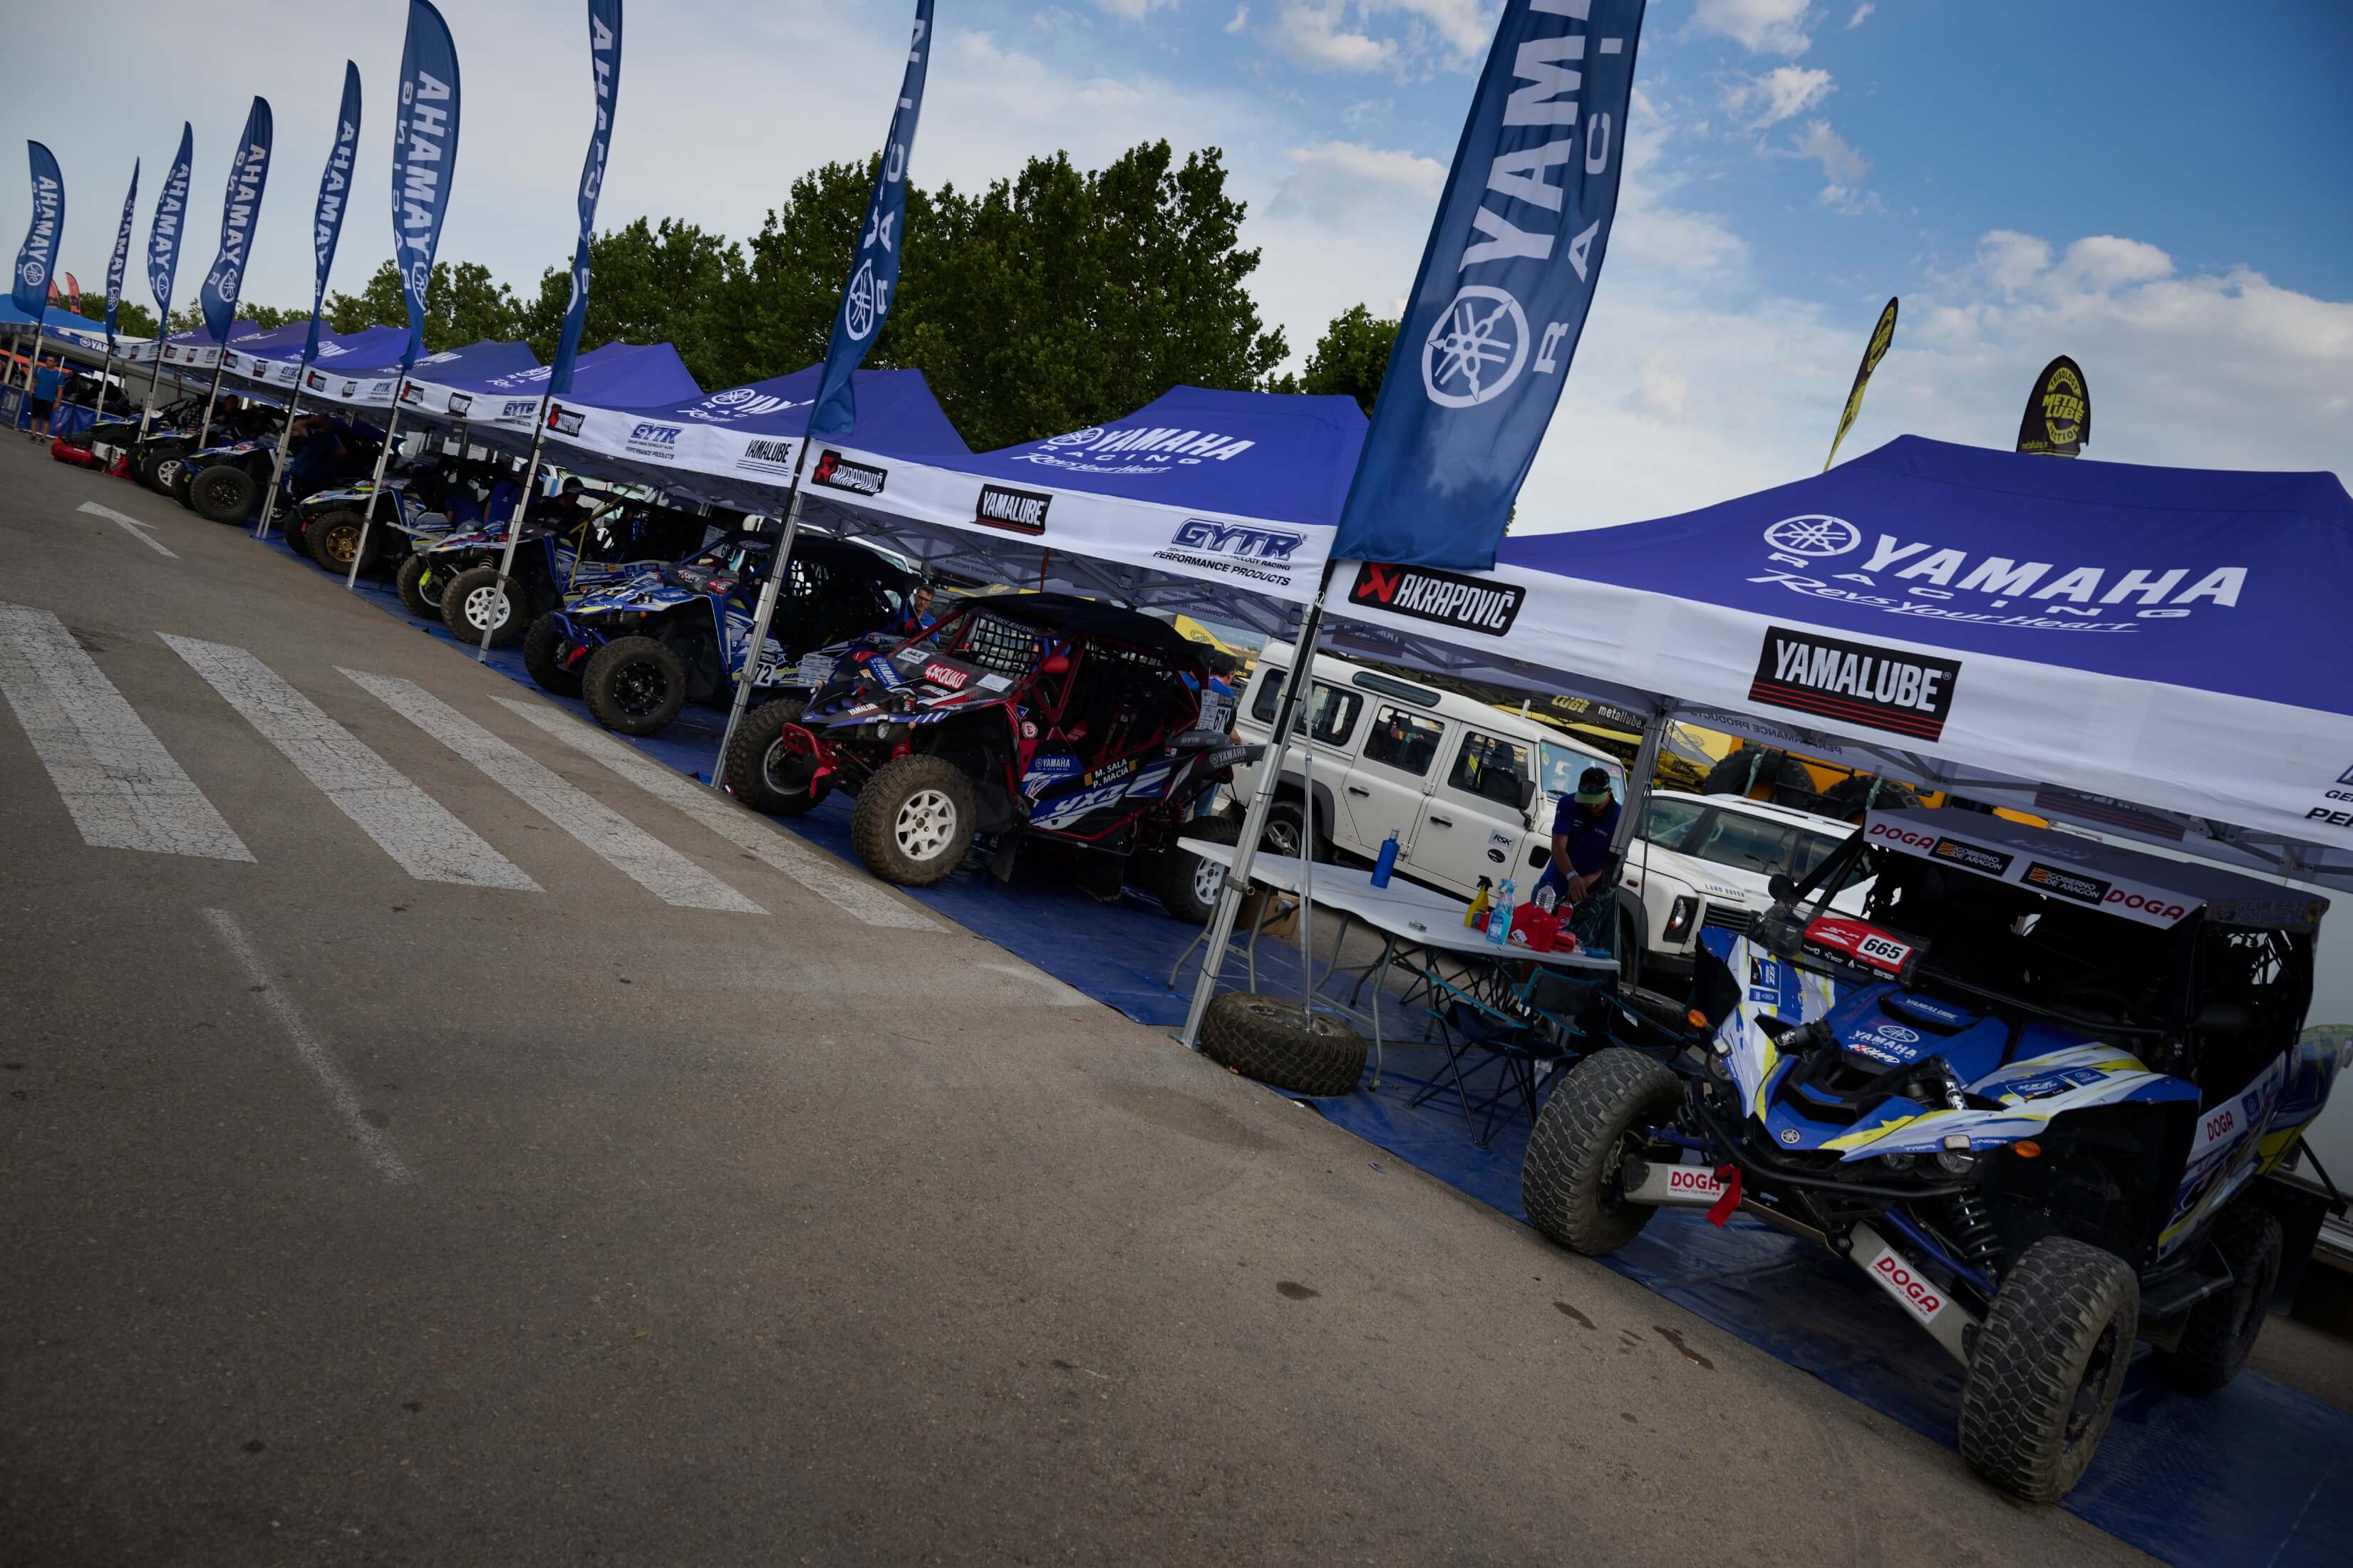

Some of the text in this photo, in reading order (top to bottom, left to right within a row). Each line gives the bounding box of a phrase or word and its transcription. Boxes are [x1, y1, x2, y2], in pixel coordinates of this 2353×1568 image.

[1458, 0, 1590, 273] YAM
[631, 423, 682, 445] GYTR
[1085, 427, 1256, 462] YAMAHA
[745, 439, 792, 463] YAMALUBE
[982, 490, 1045, 526] YAMALUBE
[1172, 518, 1303, 561] GYTR
[1153, 550, 1291, 586] PERFORMANCE PRODUCTS
[1860, 534, 2249, 608] YAMAHA
[1043, 757, 1070, 768] YAMAHA
[1107, 758, 1127, 773] SALA
[1219, 746, 1247, 763] YAMAHA
[1493, 834, 1513, 846] RSK
[1868, 823, 1935, 850] DOGA
[1955, 846, 2000, 863] GOBIERNO
[2048, 872, 2096, 891] GOBIERNO
[2104, 888, 2186, 921] DOGA
[1863, 938, 1903, 960] 665
[1905, 998, 1960, 1020] YAMALUBE
[1854, 1029, 1918, 1059] YAMAHA
[2206, 1110, 2235, 1142] DOGA
[1876, 1256, 1940, 1312] DOGA
